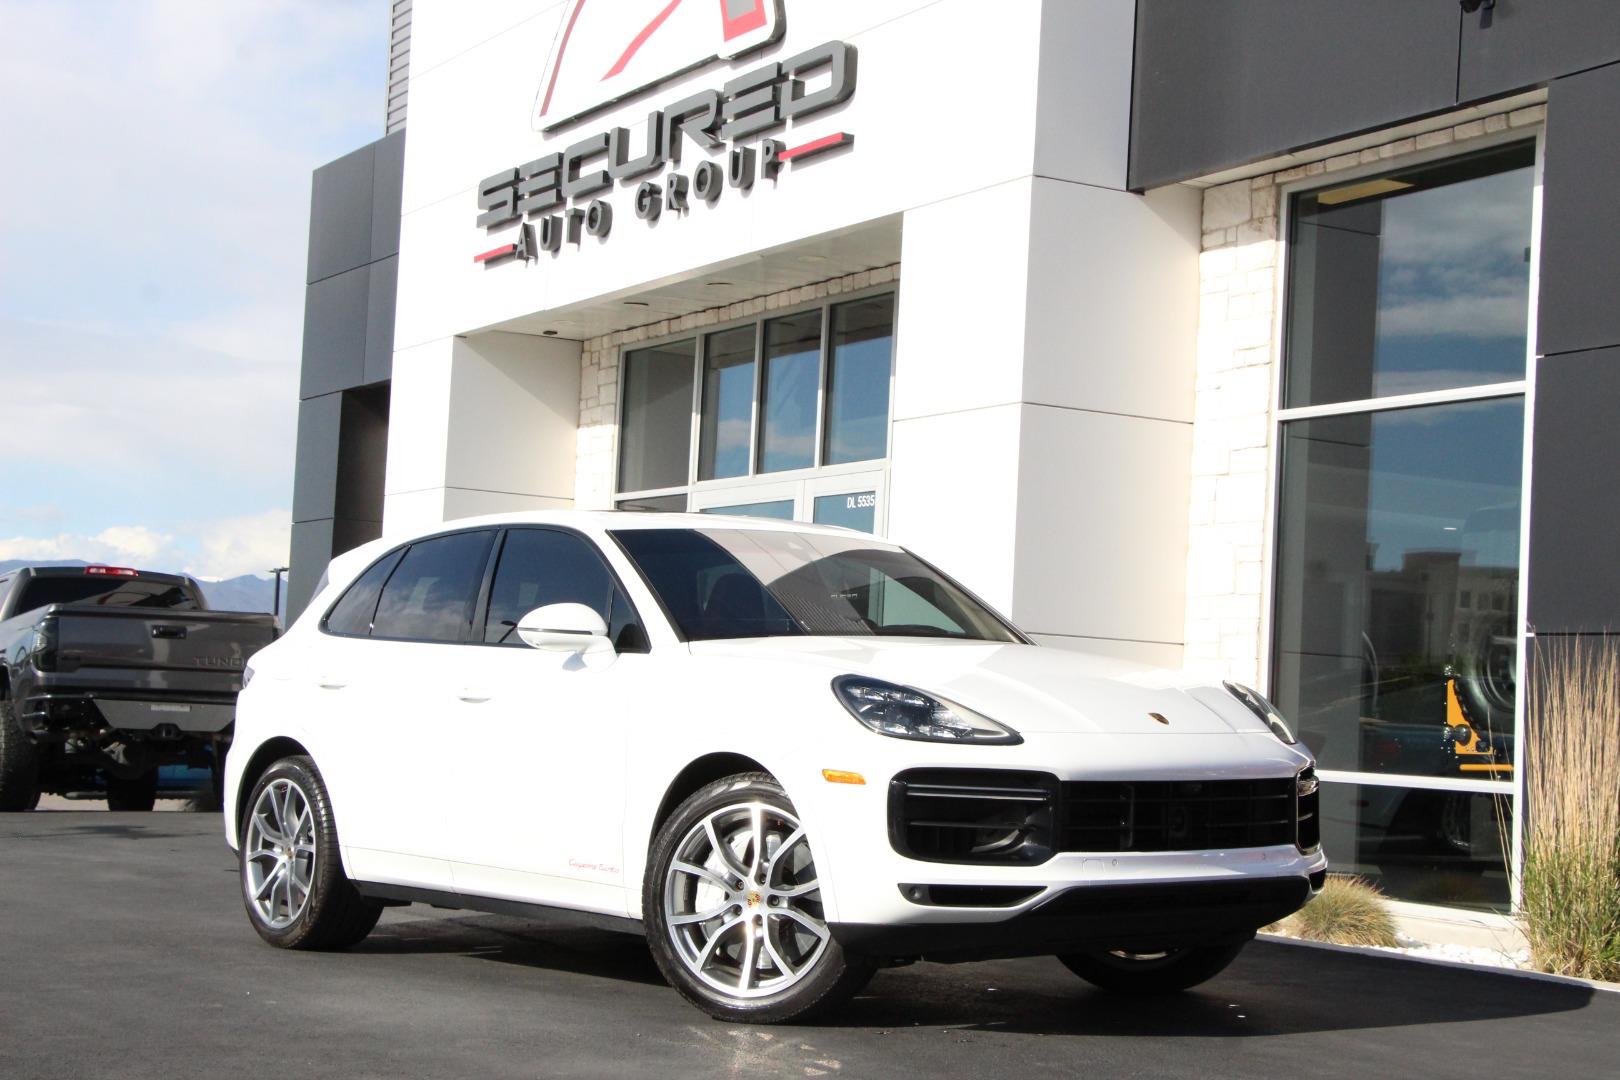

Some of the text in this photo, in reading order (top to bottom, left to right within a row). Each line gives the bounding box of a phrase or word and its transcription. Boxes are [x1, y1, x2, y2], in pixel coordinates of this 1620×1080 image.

[477, 39, 857, 228] SECURED
[514, 138, 785, 264] AUTO GROUP
[847, 496, 857, 508] DL
[192, 655, 248, 668] TUND
